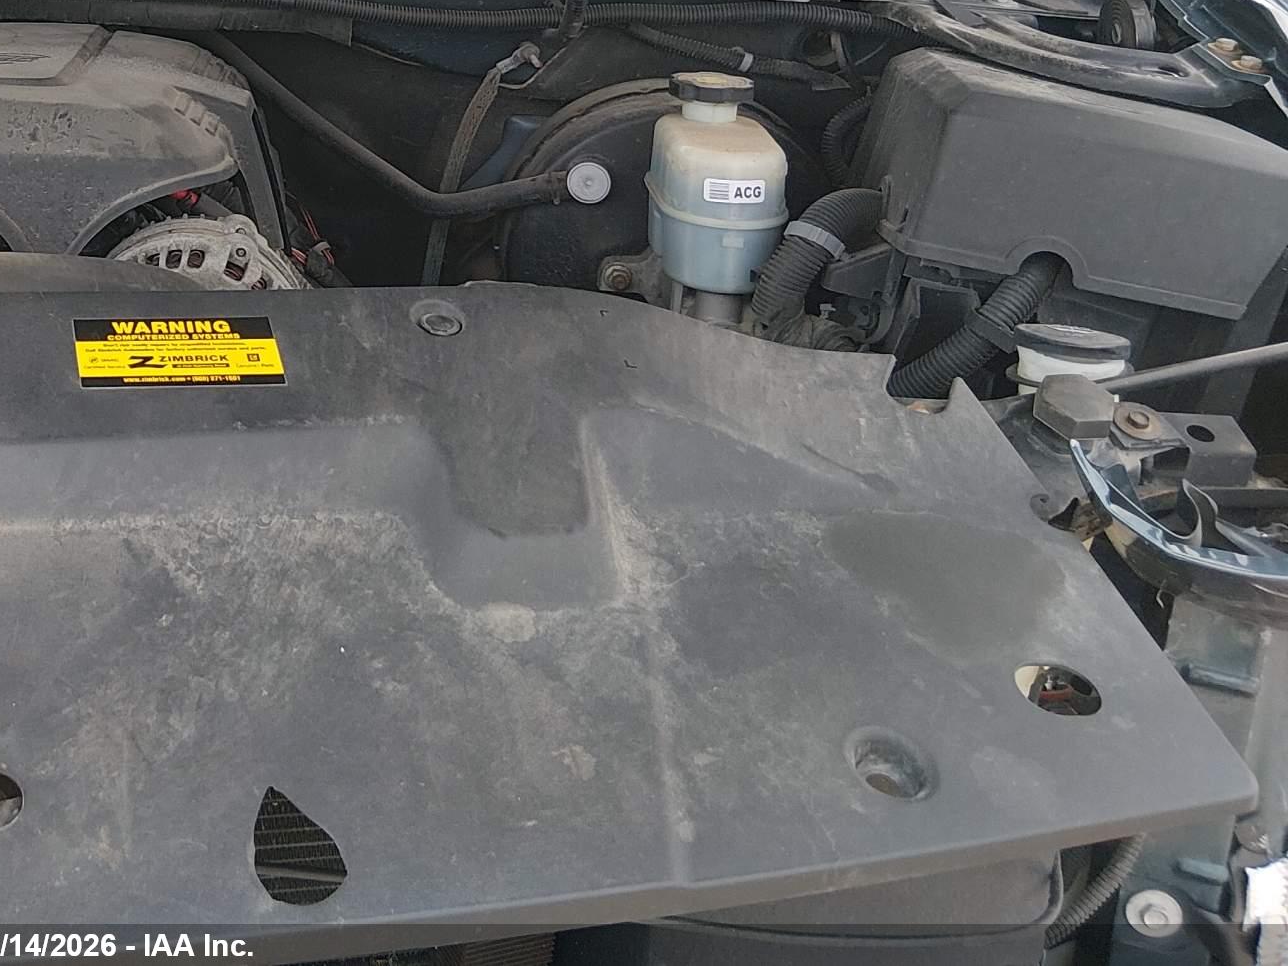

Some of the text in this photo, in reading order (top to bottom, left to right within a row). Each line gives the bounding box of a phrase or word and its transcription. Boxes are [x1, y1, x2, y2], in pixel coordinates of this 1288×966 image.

[733, 185, 762, 199] ACG
[112, 320, 231, 334] WARNING
[159, 354, 229, 362] ZIMBRICK
